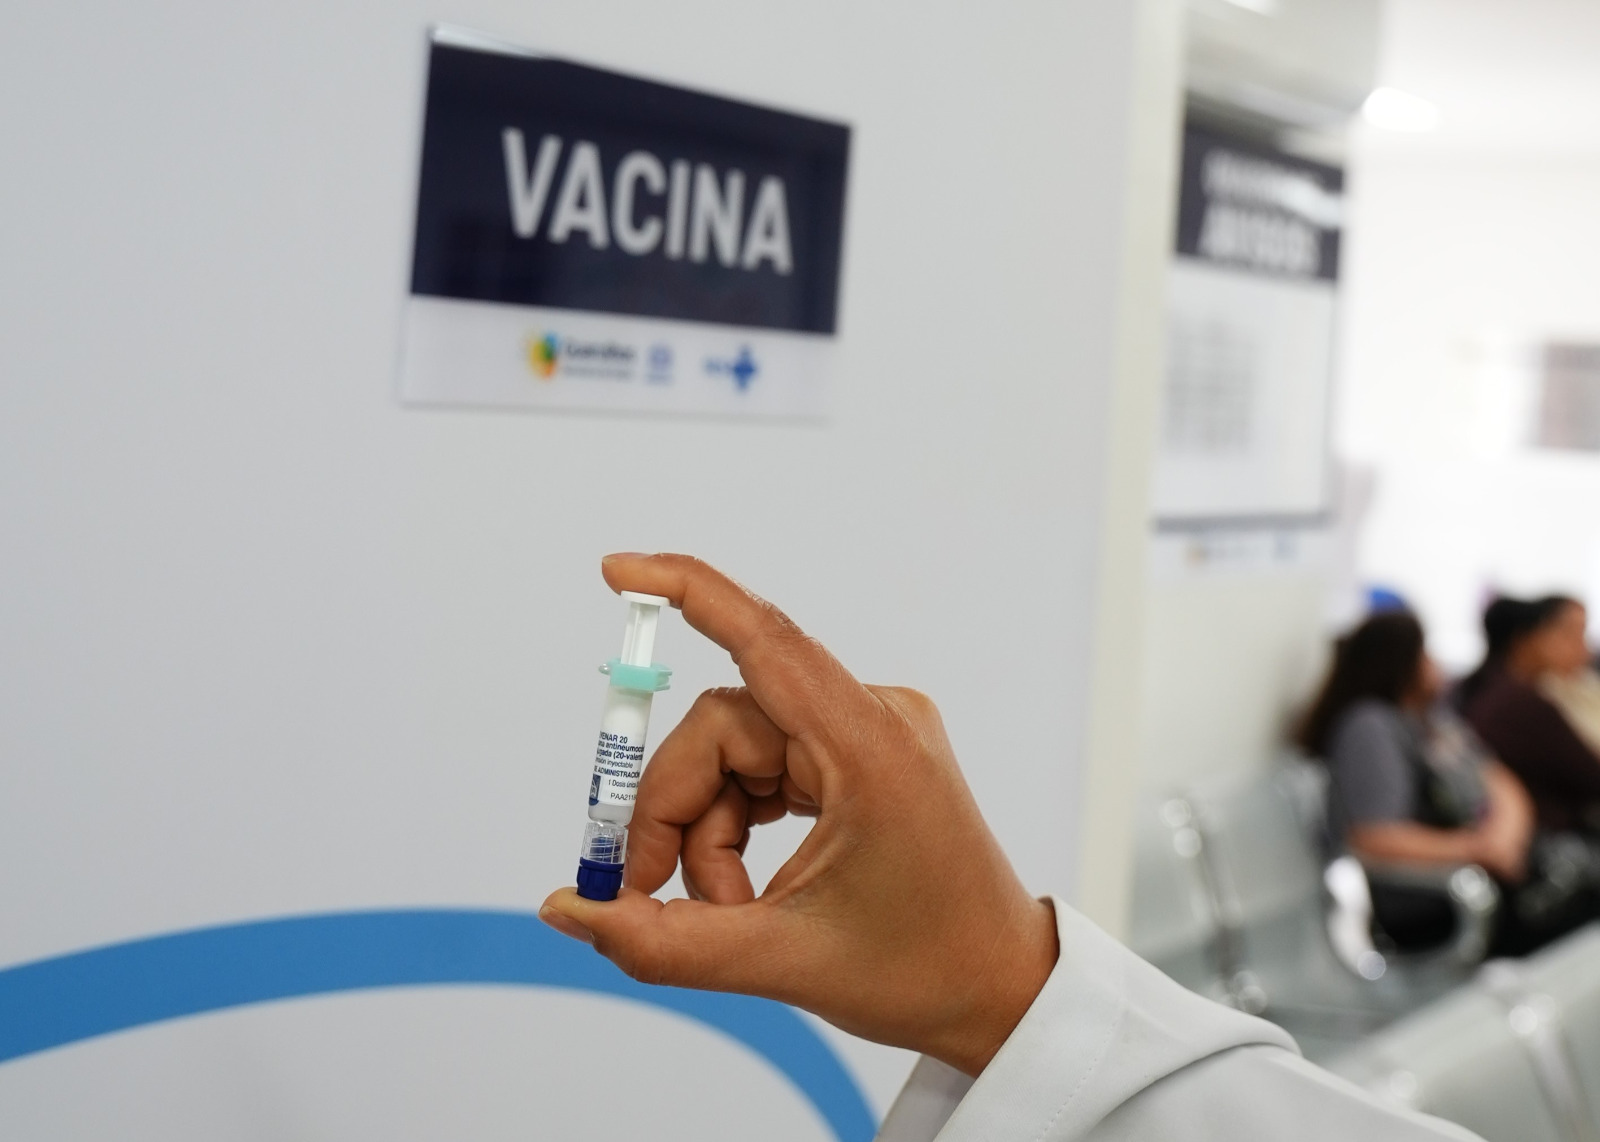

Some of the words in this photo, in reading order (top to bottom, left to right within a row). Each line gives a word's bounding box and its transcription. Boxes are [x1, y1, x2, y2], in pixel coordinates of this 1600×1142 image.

[502, 126, 793, 276] VACINA
[619, 736, 628, 744] 20
[607, 760, 633, 768] inyectable
